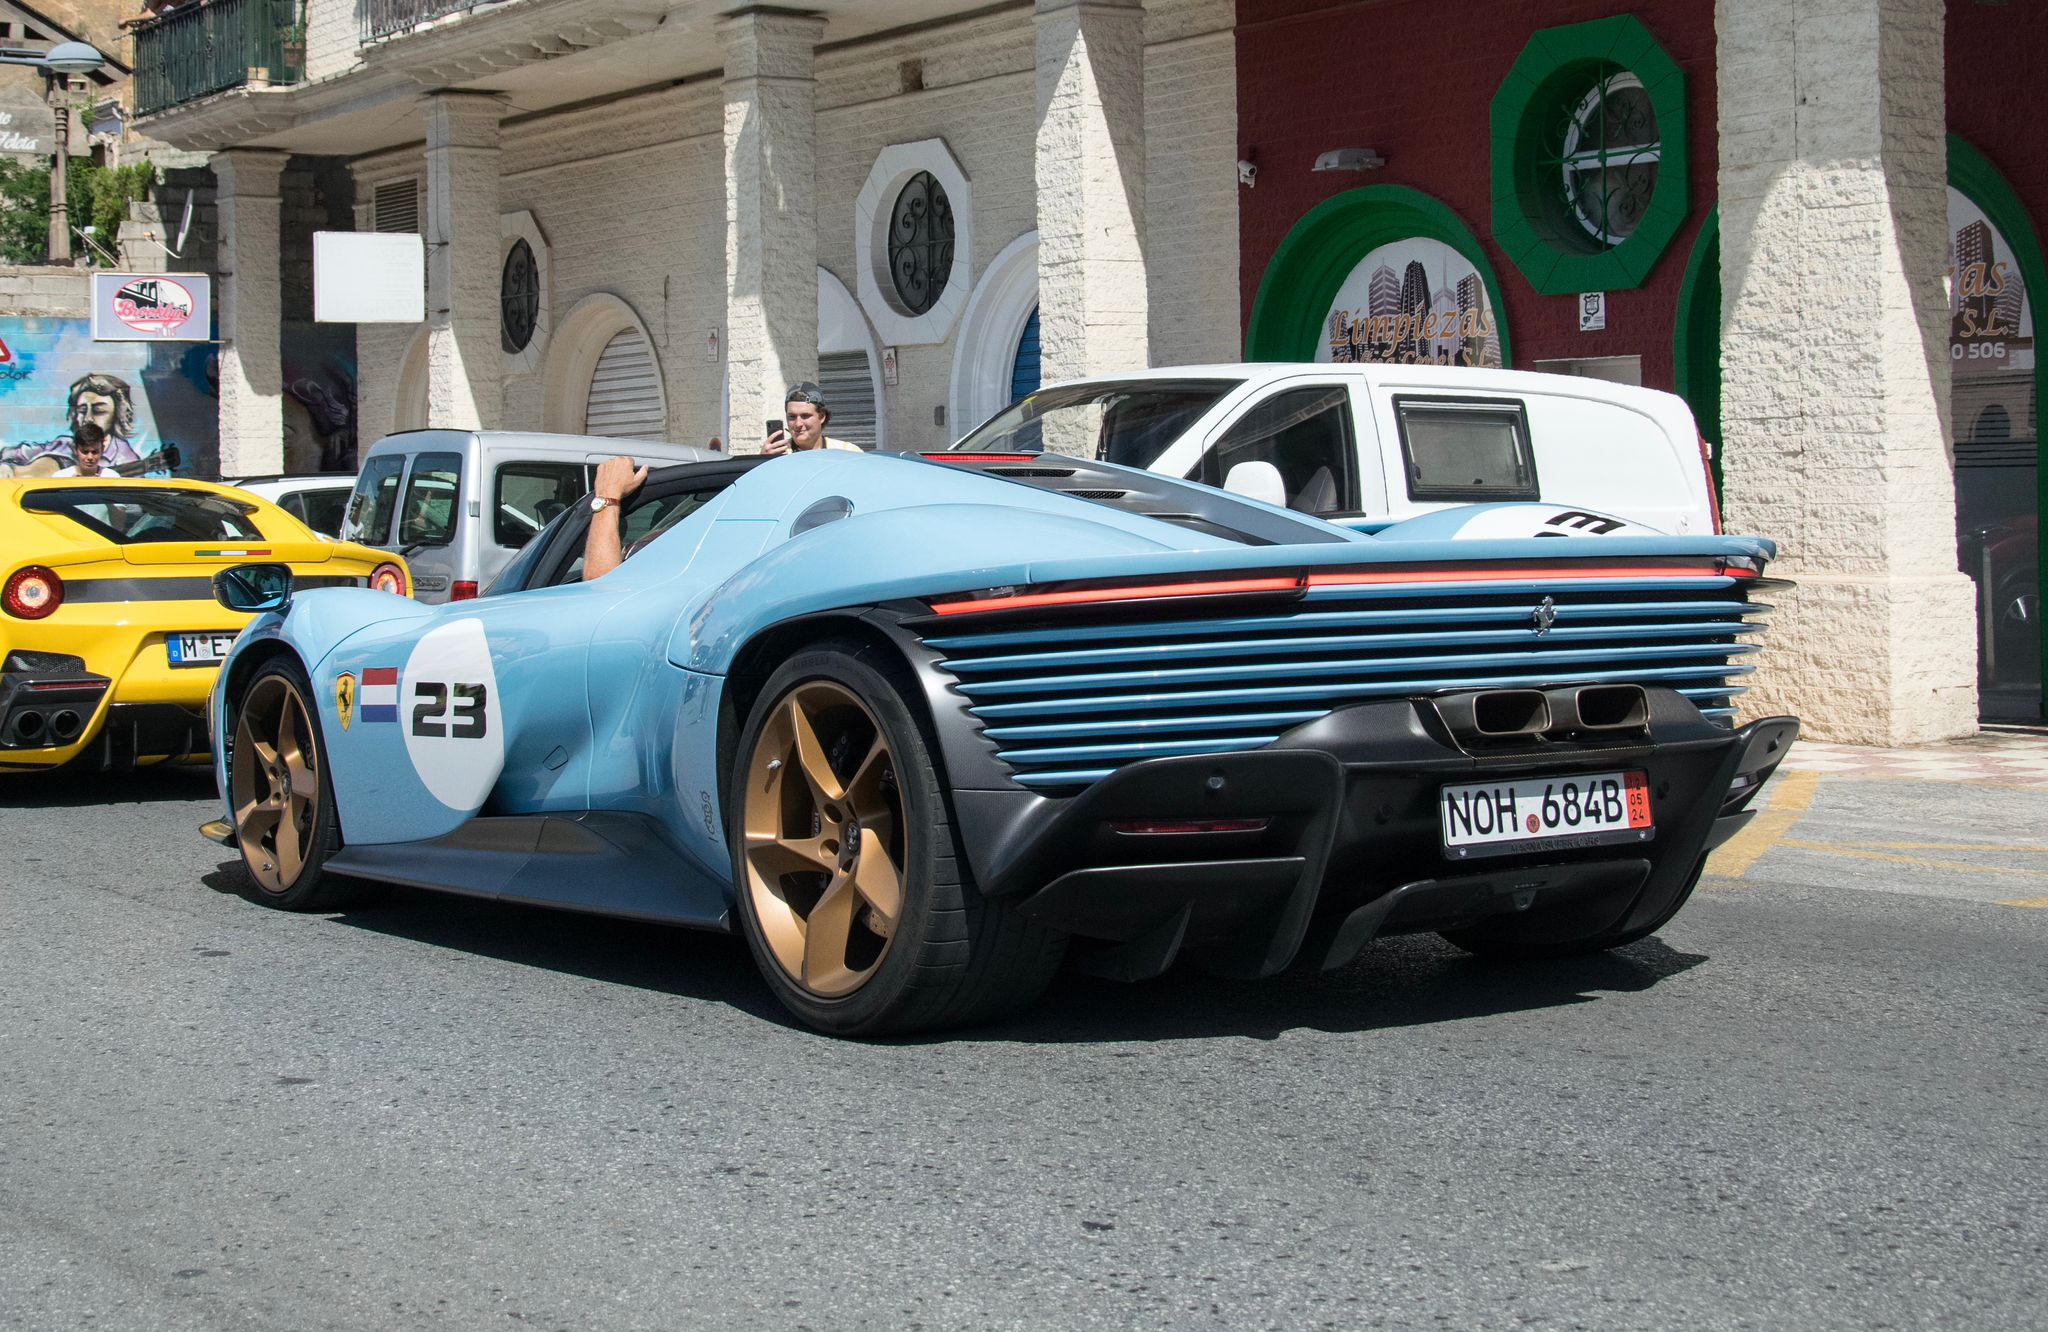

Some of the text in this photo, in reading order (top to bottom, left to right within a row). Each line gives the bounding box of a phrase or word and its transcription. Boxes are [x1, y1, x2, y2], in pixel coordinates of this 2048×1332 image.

[117, 299, 188, 327] Brooklyn
[1960, 308, 2009, 337] S.L.
[1329, 304, 1493, 357] Limpiezas
[1968, 342, 2006, 359] 506
[181, 636, 197, 658] M
[412, 682, 487, 739] 23
[1447, 779, 1623, 838] NOH 684B
[1630, 793, 1643, 806] 05
[1631, 808, 1645, 821] 24
